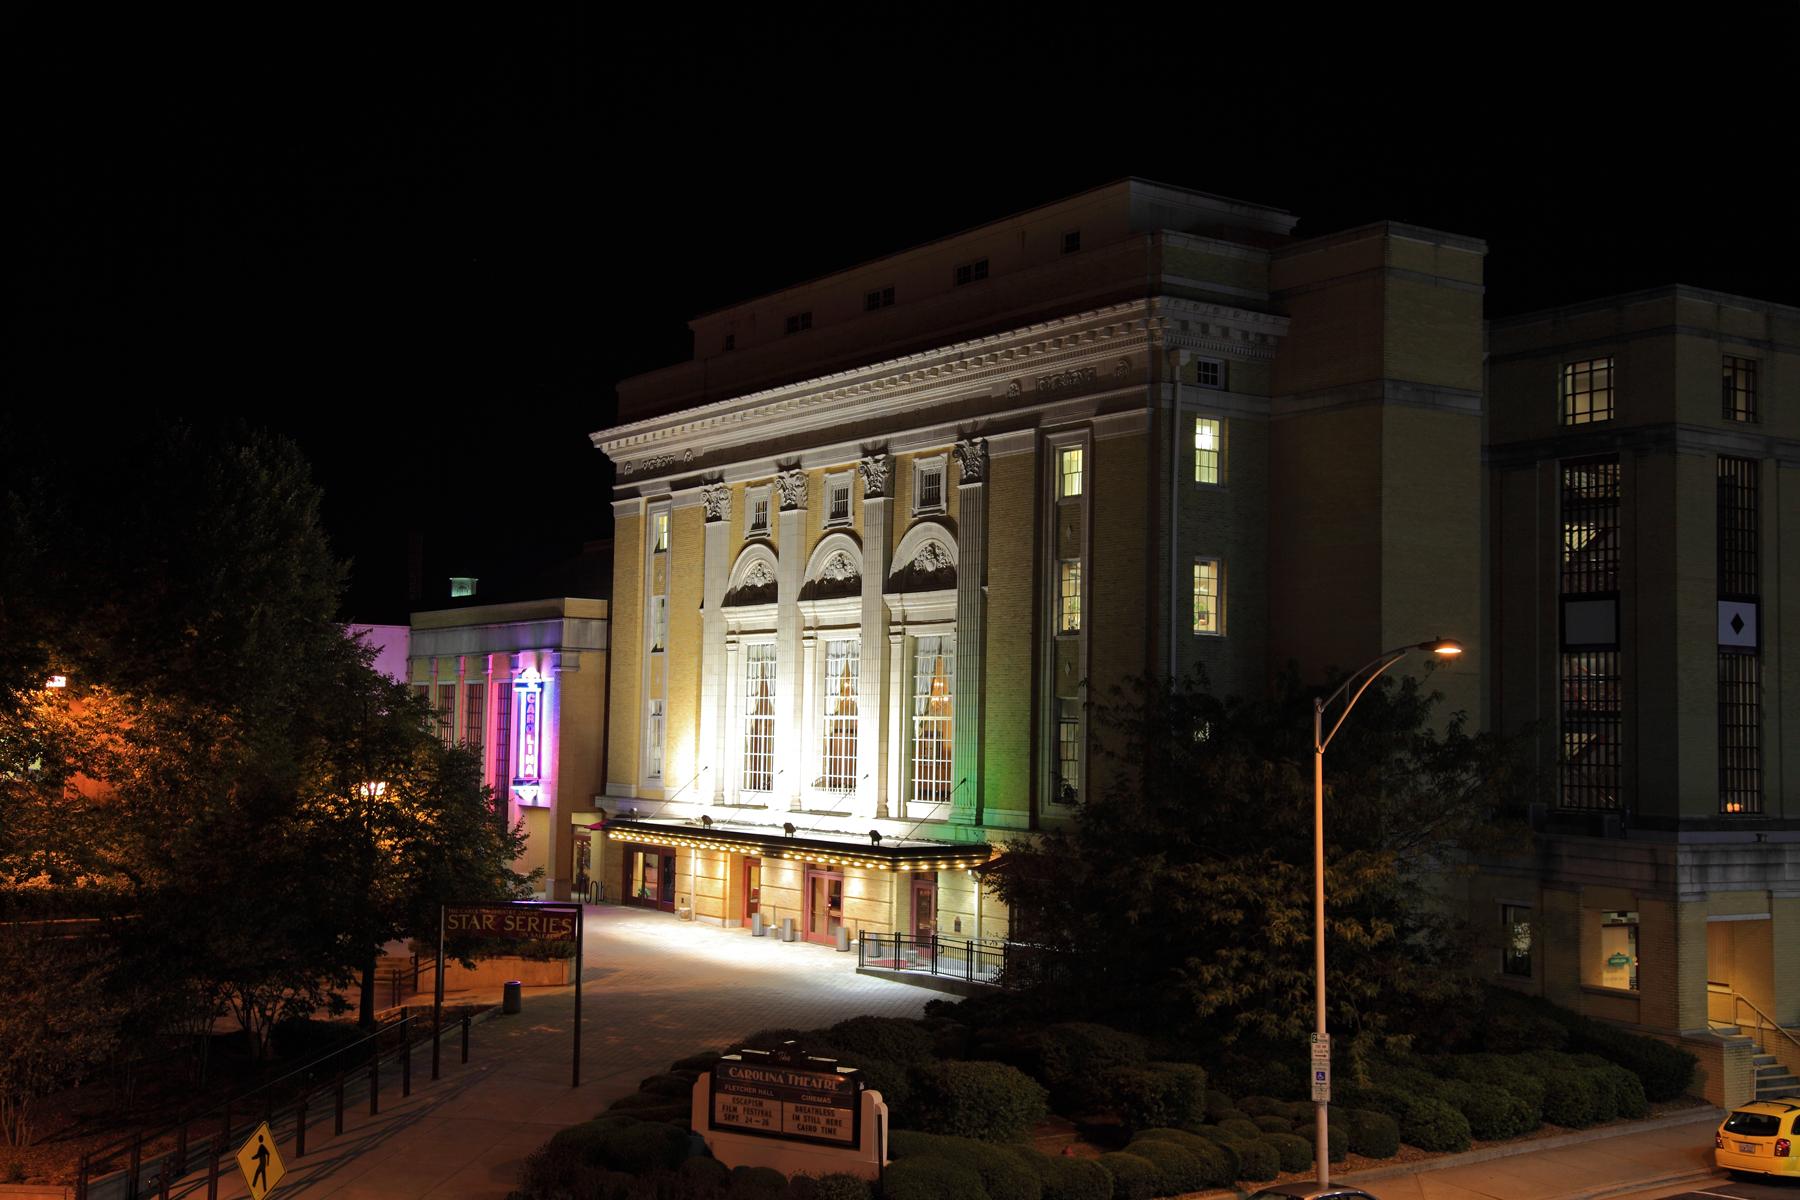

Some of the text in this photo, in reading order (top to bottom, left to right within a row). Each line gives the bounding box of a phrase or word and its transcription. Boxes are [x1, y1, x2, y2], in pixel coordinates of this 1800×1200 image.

[524, 693, 536, 777] CAROLINA
[447, 913, 573, 933] STAR SERIES
[728, 1066, 840, 1091] CAROLINA THEATRE
[724, 1083, 775, 1097] FLETCHER HALL
[732, 1096, 763, 1107] ESCAPISM
[800, 1094, 832, 1104] CINEMAS
[722, 1104, 773, 1118] FILM FESTIVAL
[723, 1113, 740, 1122] SEPT
[794, 1105, 836, 1117] BREATHLESS
[803, 1115, 821, 1125] STILL
[826, 1118, 843, 1127] HERE
[796, 1123, 838, 1136] CAIRO TIME
